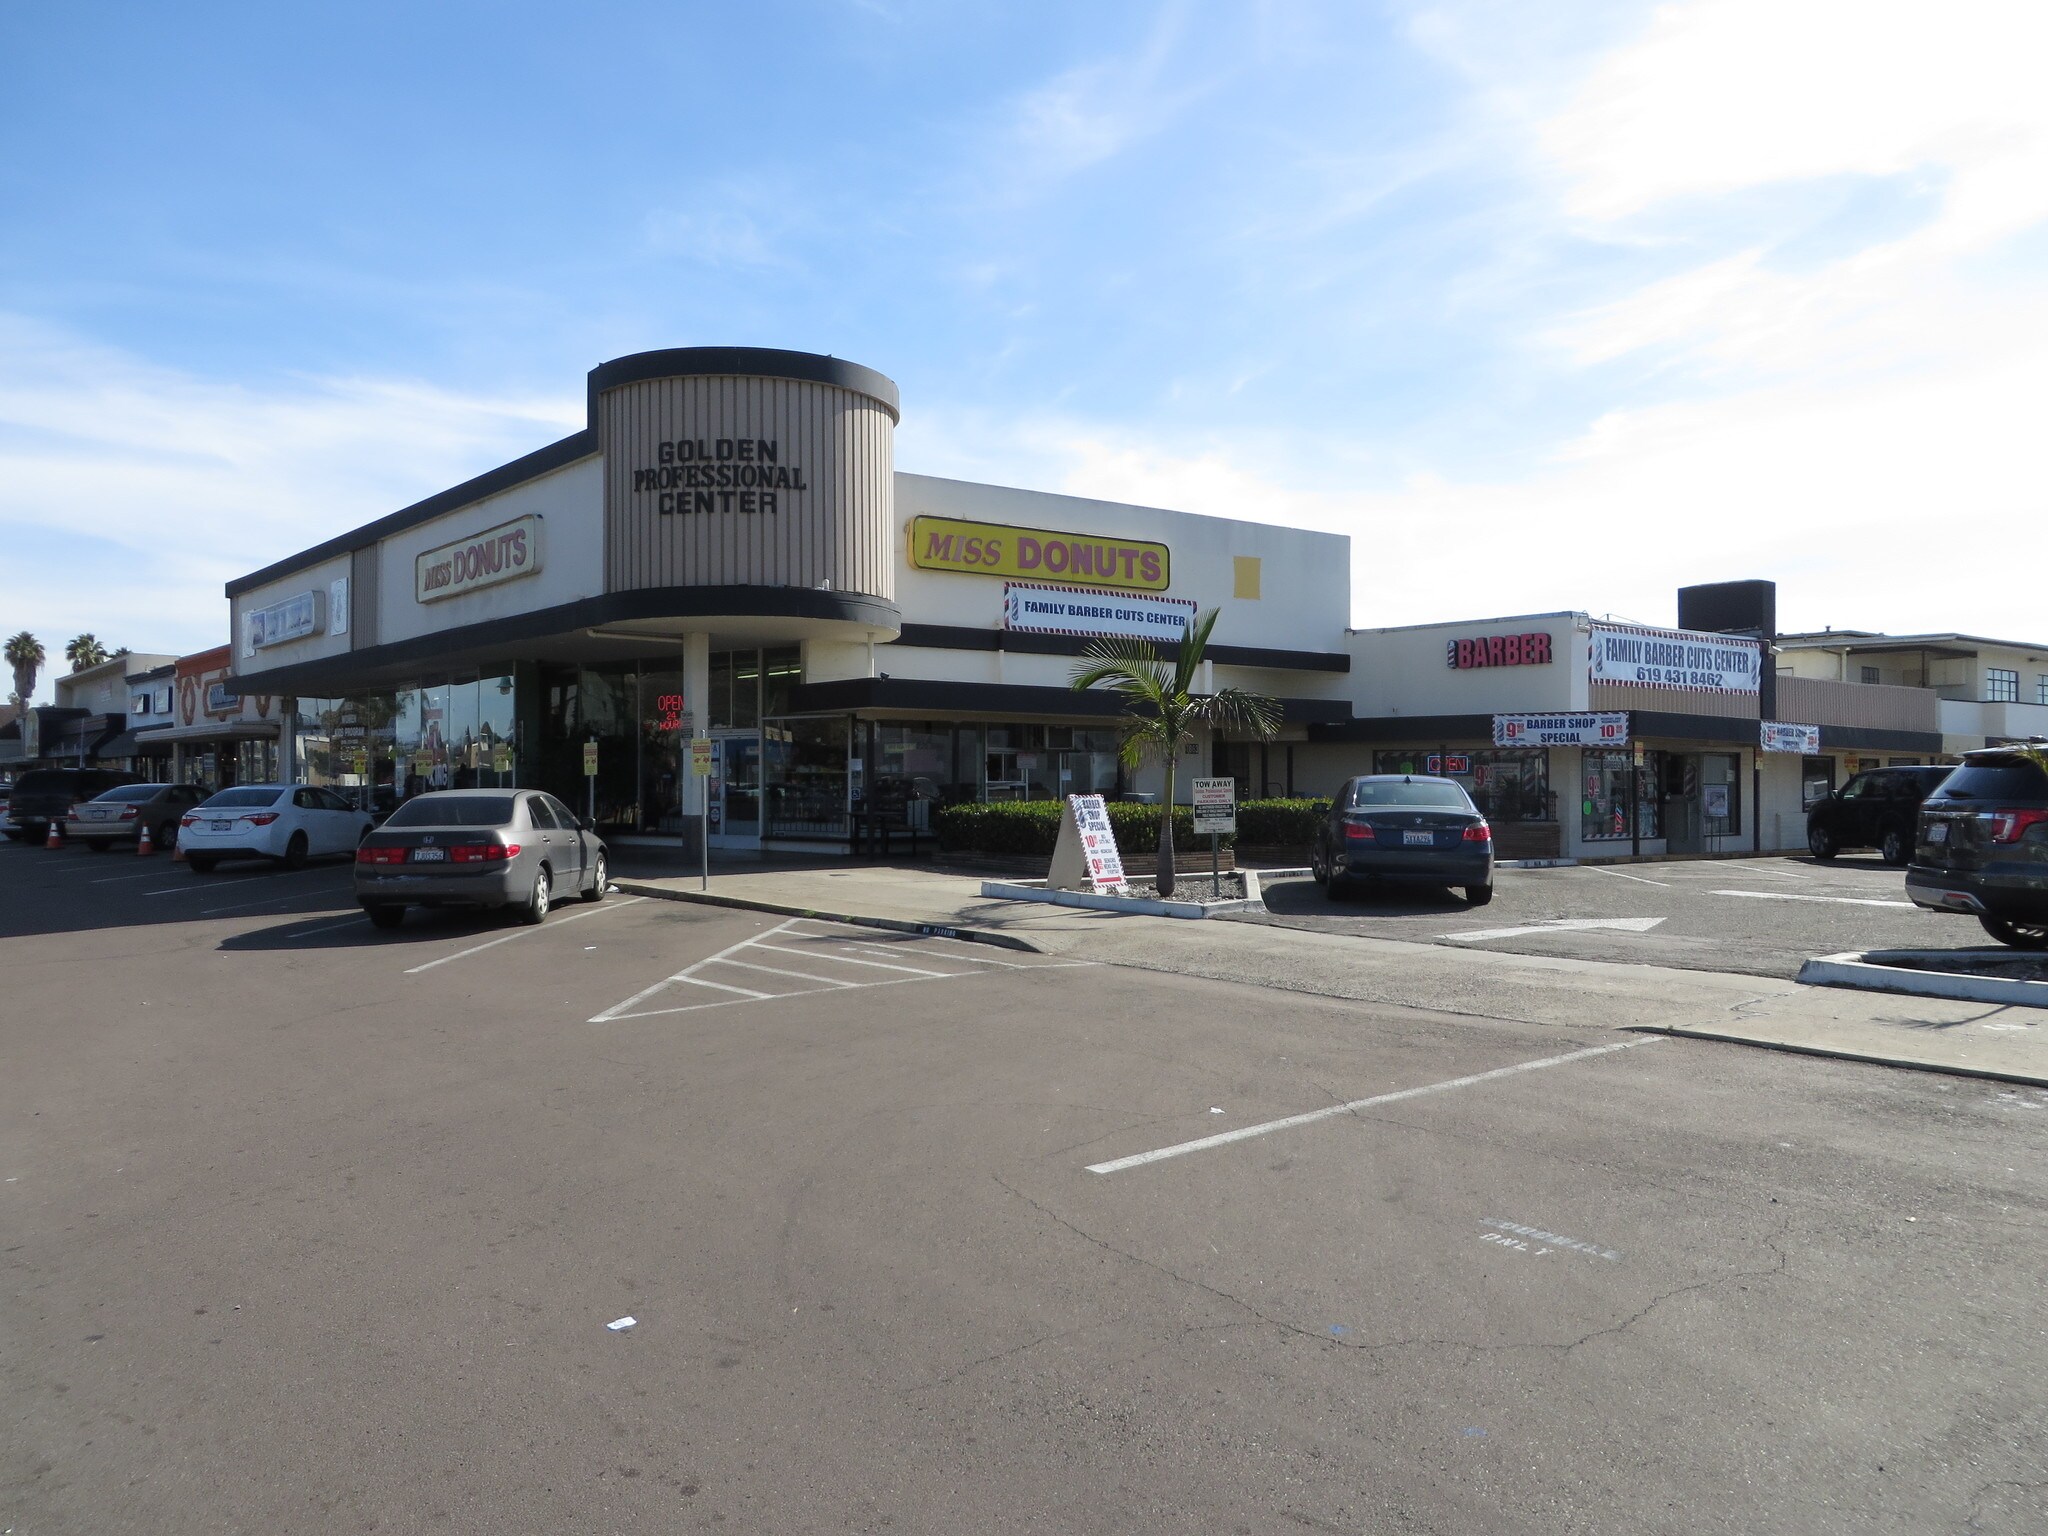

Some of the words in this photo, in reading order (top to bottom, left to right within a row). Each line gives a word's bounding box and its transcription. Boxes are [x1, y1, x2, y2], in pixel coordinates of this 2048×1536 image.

[658, 439, 777, 463] GOLDEN
[634, 465, 807, 492] PROFESSIONAL
[659, 491, 777, 514] CENTER
[424, 561, 452, 591] MISS
[453, 528, 527, 584] DONUTS
[924, 533, 1002, 566] MISS
[1018, 537, 1161, 581] DONUTS
[1024, 601, 1065, 616] FAMILY
[1068, 605, 1112, 619] BARBER
[1115, 609, 1144, 622] CUTS
[1147, 612, 1186, 626] CENTER
[1458, 633, 1552, 669] BARBER
[1605, 638, 1642, 663] FAMILY
[1645, 642, 1684, 668] BARBER
[1687, 646, 1712, 671] CUTS
[1714, 649, 1749, 674] CENTER
[1637, 667, 1661, 681] 619
[1665, 669, 1687, 684] 431
[1690, 672, 1722, 687] 8462
[657, 695, 684, 711] OPEN
[666, 711, 677, 720] 24
[1526, 719, 1566, 729] BARBER
[1568, 718, 1596, 728] SHOP
[1540, 732, 1581, 743] SPECIAL
[1430, 758, 1466, 771] OEN
[1211, 781, 1231, 789] AWAY
[1083, 800, 1101, 809] BARBER
[1089, 811, 1101, 820] SHOP
[1088, 821, 1107, 831] SPECIAL
[933, 927, 957, 938] PARKING
